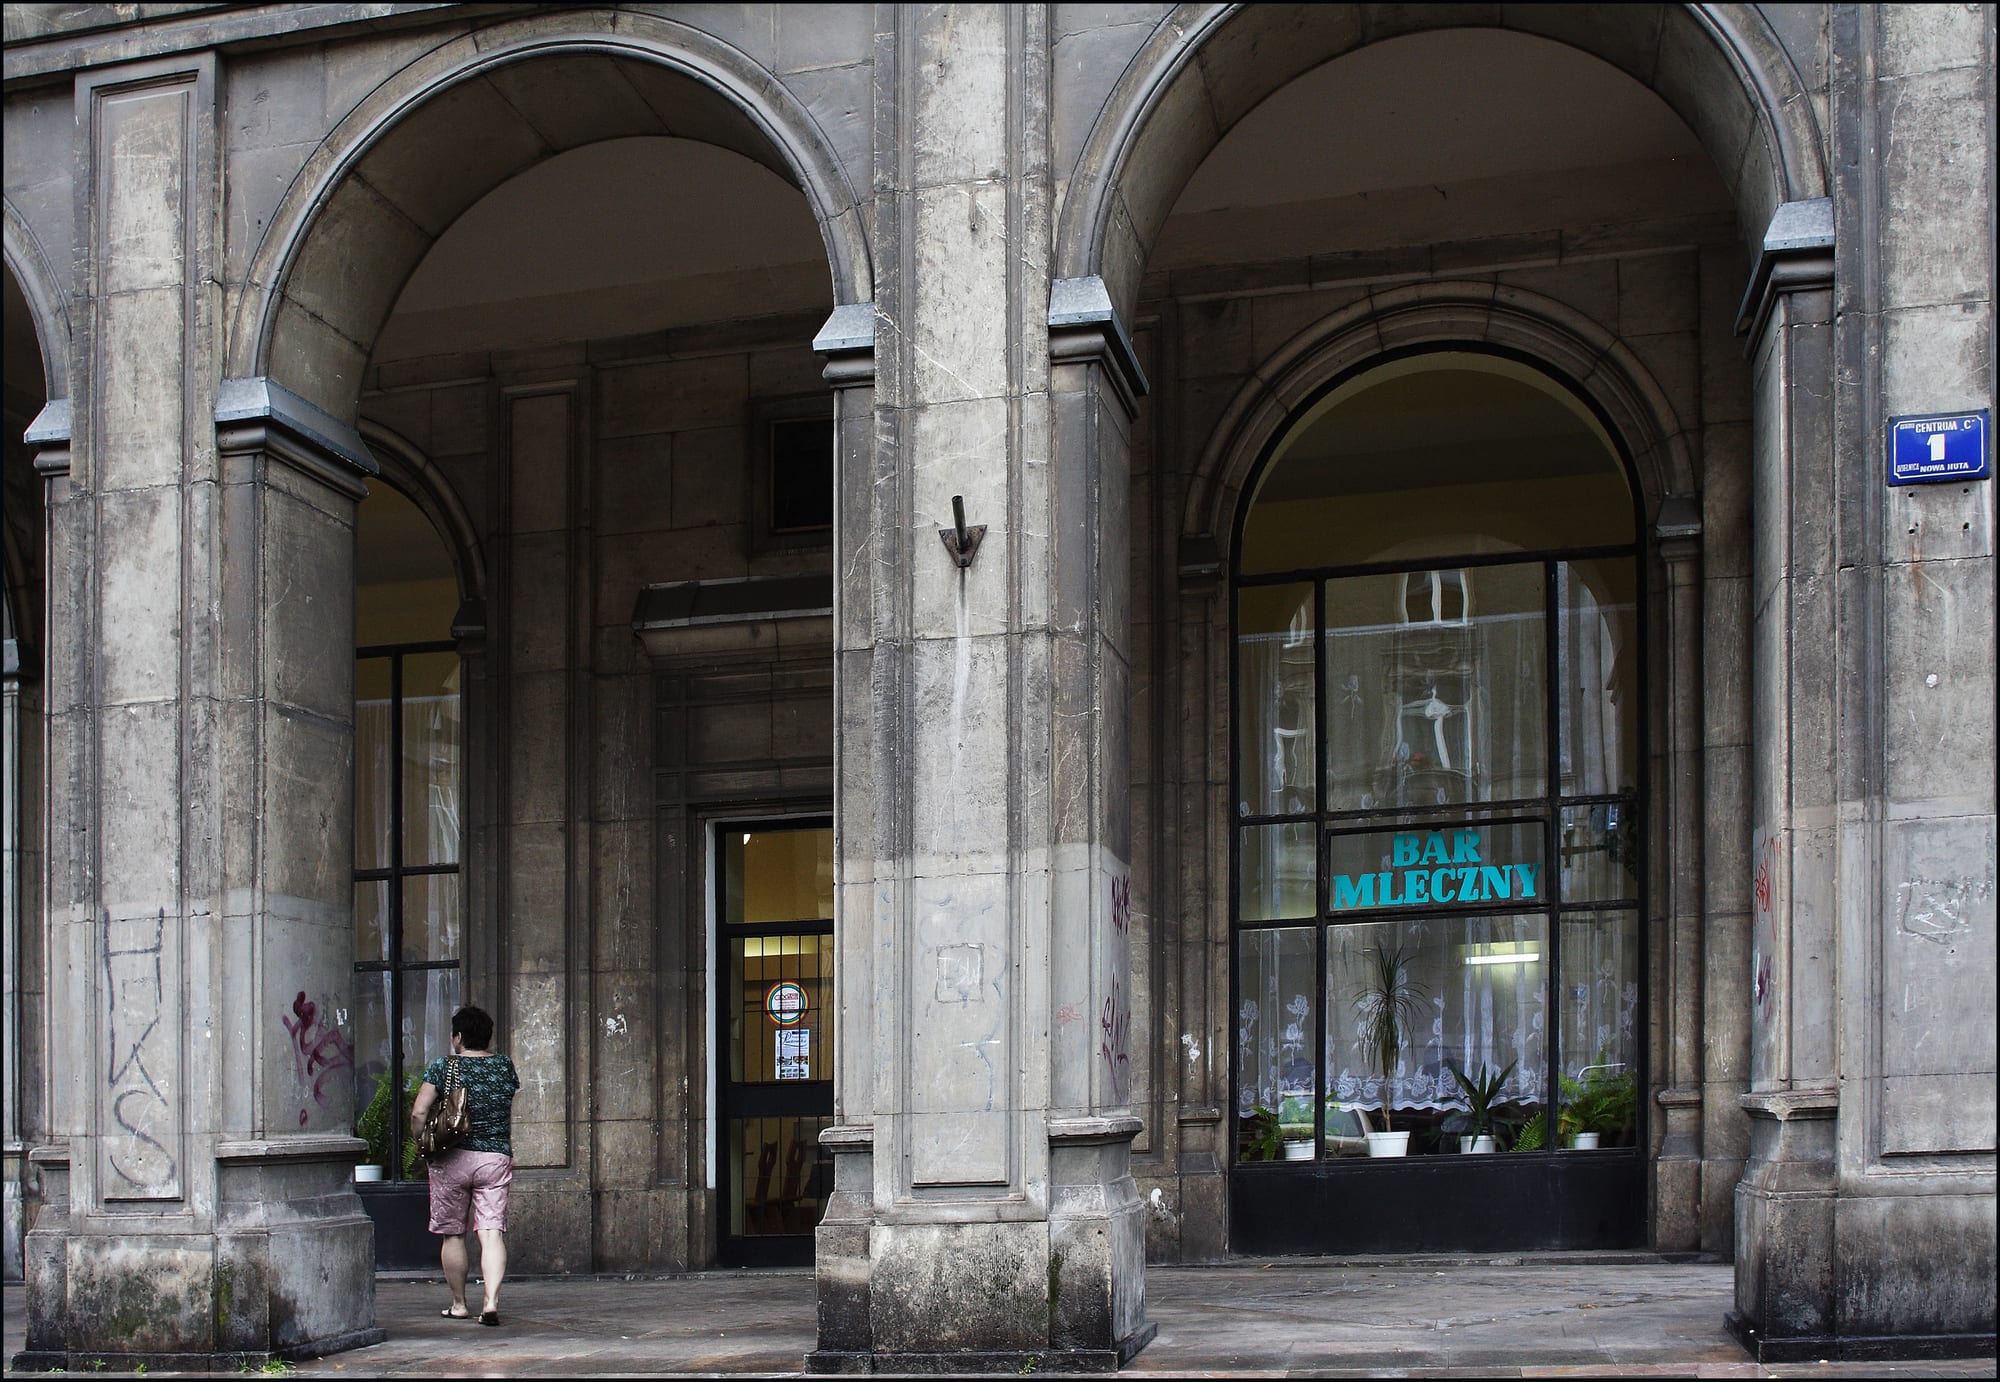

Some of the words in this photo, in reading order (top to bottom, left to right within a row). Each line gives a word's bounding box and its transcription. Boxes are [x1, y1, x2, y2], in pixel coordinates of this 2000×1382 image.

[1915, 421, 1958, 433] CENTRUM
[1927, 434, 1945, 461] 1
[1920, 464, 1946, 473] NOWA
[1947, 462, 1970, 471] HUTA
[1392, 830, 1482, 867] BAR
[1333, 863, 1542, 909] MLECZNY
